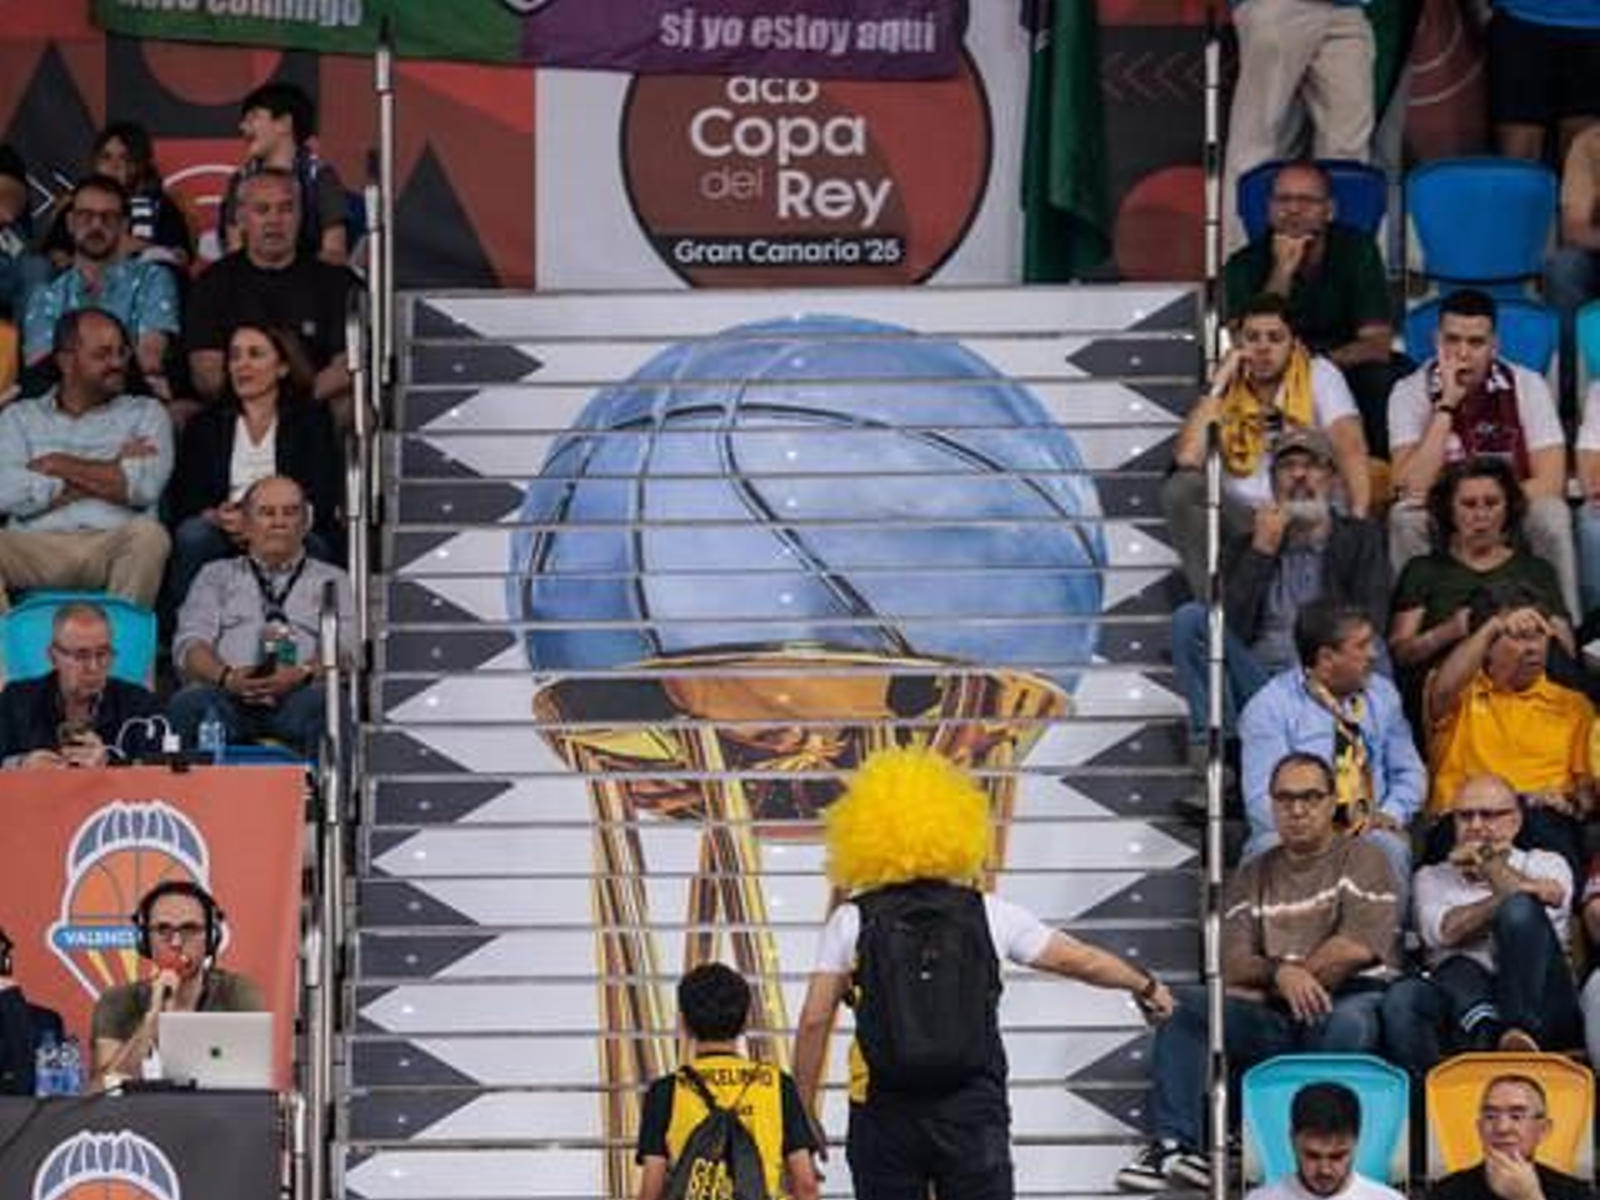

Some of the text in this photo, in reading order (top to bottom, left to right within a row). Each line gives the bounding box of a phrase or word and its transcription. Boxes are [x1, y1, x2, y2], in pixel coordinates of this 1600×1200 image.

[659, 8, 694, 47] si
[701, 17, 743, 49] yo
[751, 14, 850, 55] estoy
[690, 107, 866, 166] Copa
[701, 166, 893, 228] del Rey
[674, 239, 742, 263] Gran
[749, 238, 860, 263] Canaria
